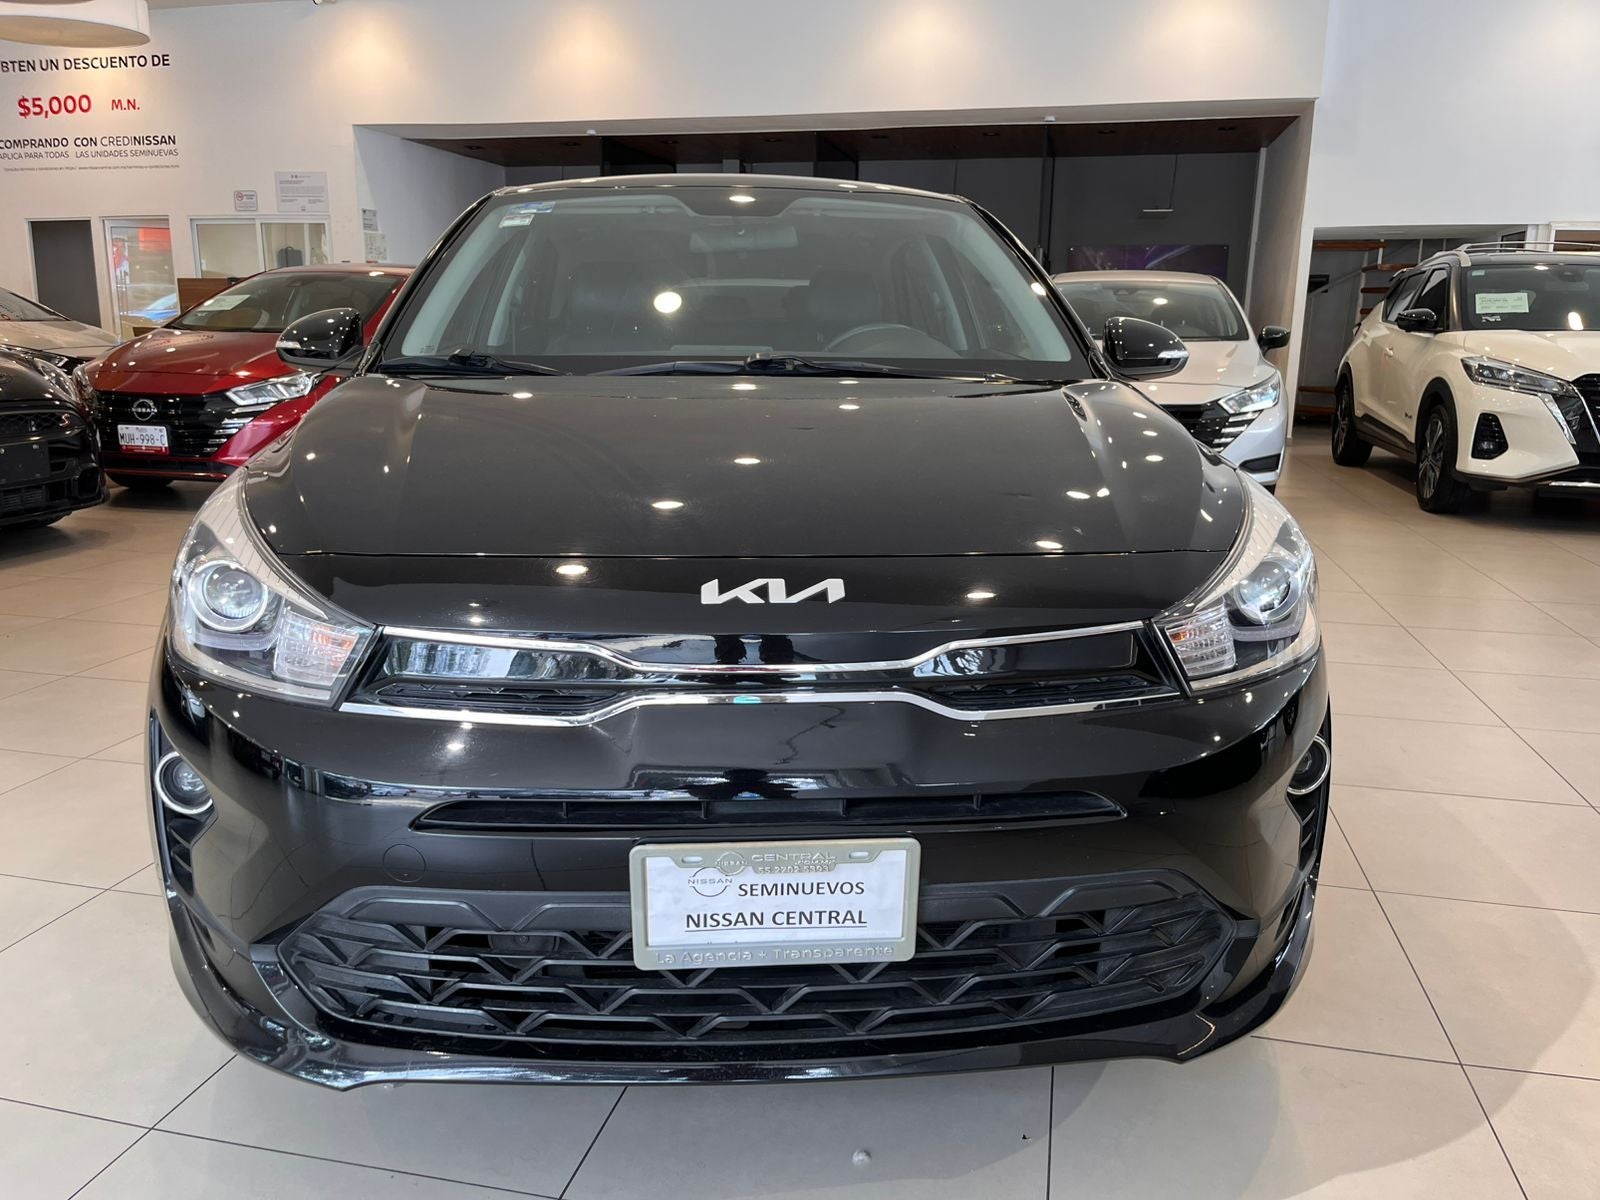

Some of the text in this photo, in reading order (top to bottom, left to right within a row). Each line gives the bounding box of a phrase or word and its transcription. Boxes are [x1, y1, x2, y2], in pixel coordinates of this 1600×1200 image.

[40, 58, 59, 71] UN
[64, 55, 148, 70] DESCUENTO
[151, 54, 170, 67] DE
[18, 94, 141, 119] $5,000 M.N.
[0, 135, 176, 149] COMPRANDO CON CREDINISSAN
[24, 151, 43, 159] PARA
[44, 151, 70, 159] TODAS
[75, 150, 89, 158] LAS
[90, 149, 129, 158] UNIDADES
[130, 148, 179, 157] SEMINUEVAS
[701, 578, 846, 605] KIA
[751, 851, 837, 862] CENTRAL
[687, 877, 733, 885] NISSAN
[737, 881, 866, 898] SEMINUEVOS
[686, 909, 868, 929] NISSAN CENTRAL
[656, 950, 677, 965] La
[682, 950, 753, 966] Agencia
[773, 945, 894, 962] Transparente
